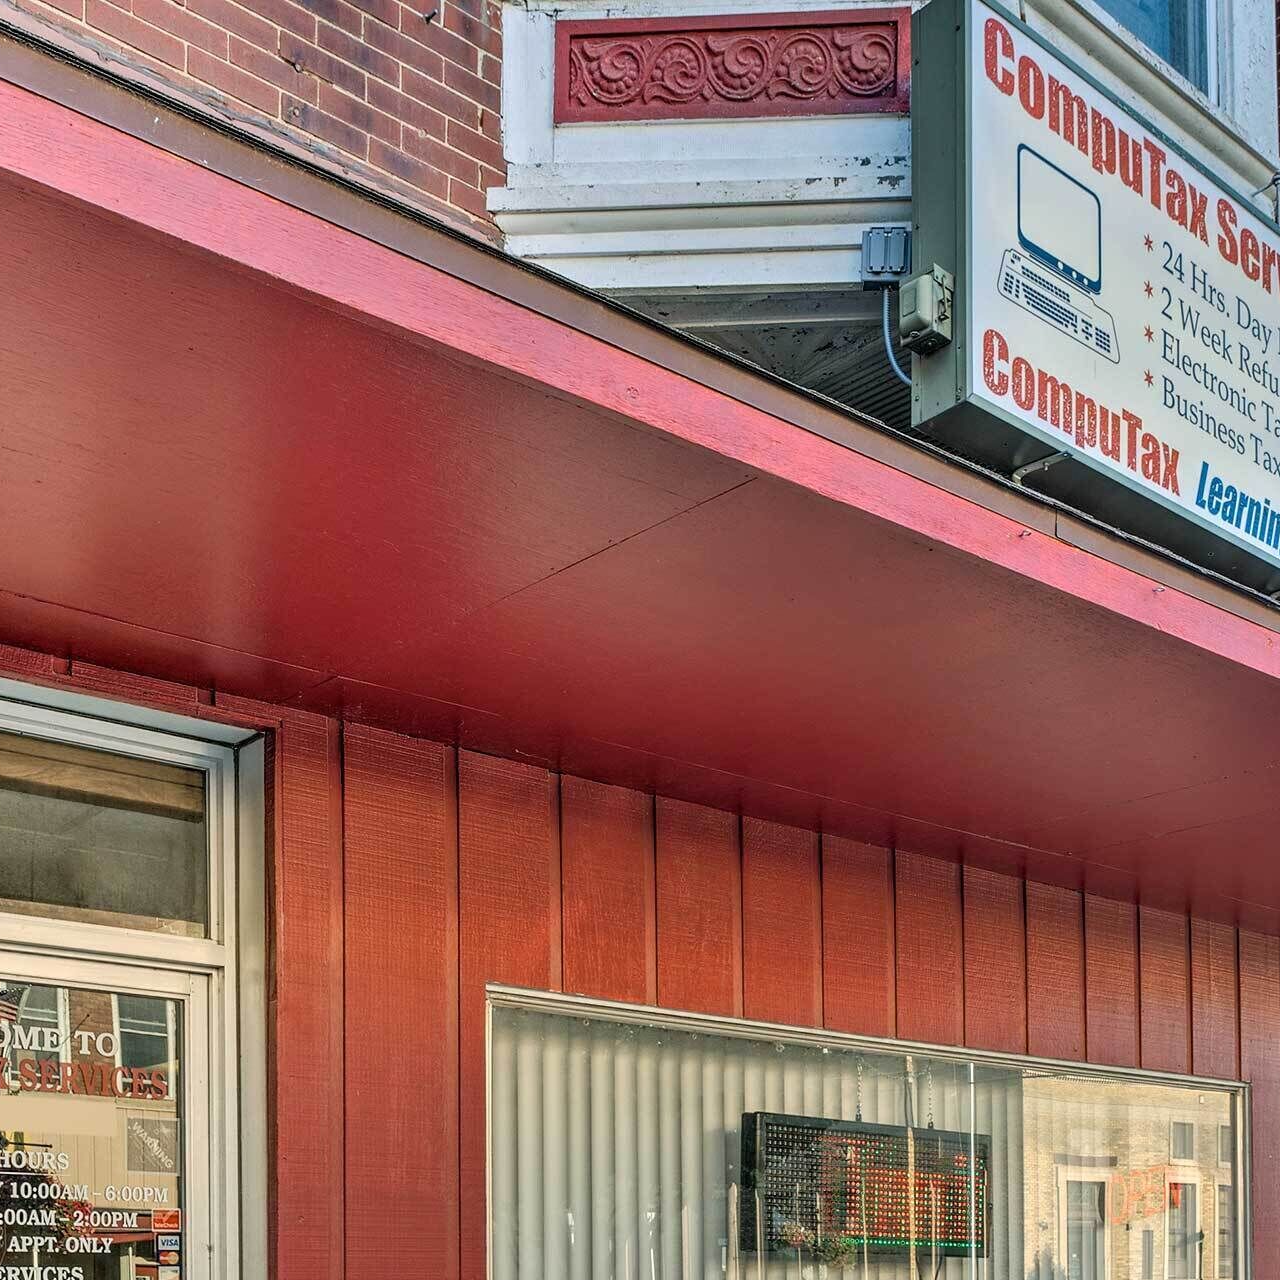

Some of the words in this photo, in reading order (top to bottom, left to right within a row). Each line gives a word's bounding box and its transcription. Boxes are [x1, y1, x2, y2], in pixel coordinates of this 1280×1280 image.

[983, 17, 1209, 247] CompuTax
[1163, 241, 1184, 283] 24
[1190, 261, 1230, 318] Hrs.
[1236, 296, 1272, 354] Day
[1161, 287, 1173, 320] 2
[1179, 298, 1233, 364] Week
[1161, 329, 1256, 422] Electronic
[983, 328, 1181, 496] CompuTax
[1161, 375, 1246, 455] Business
[74, 1030, 119, 1057] TO
[19, 1058, 168, 1100] SERVICES
[131, 1121, 175, 1169] WARNING
[10, 1182, 88, 1201] 10:00AM
[104, 1185, 169, 1203] 6:00PM
[72, 1211, 139, 1228] 2:00PM
[160, 1239, 179, 1247] VISA
[8, 1236, 61, 1253] APPT.
[65, 1236, 114, 1253] ONLY
